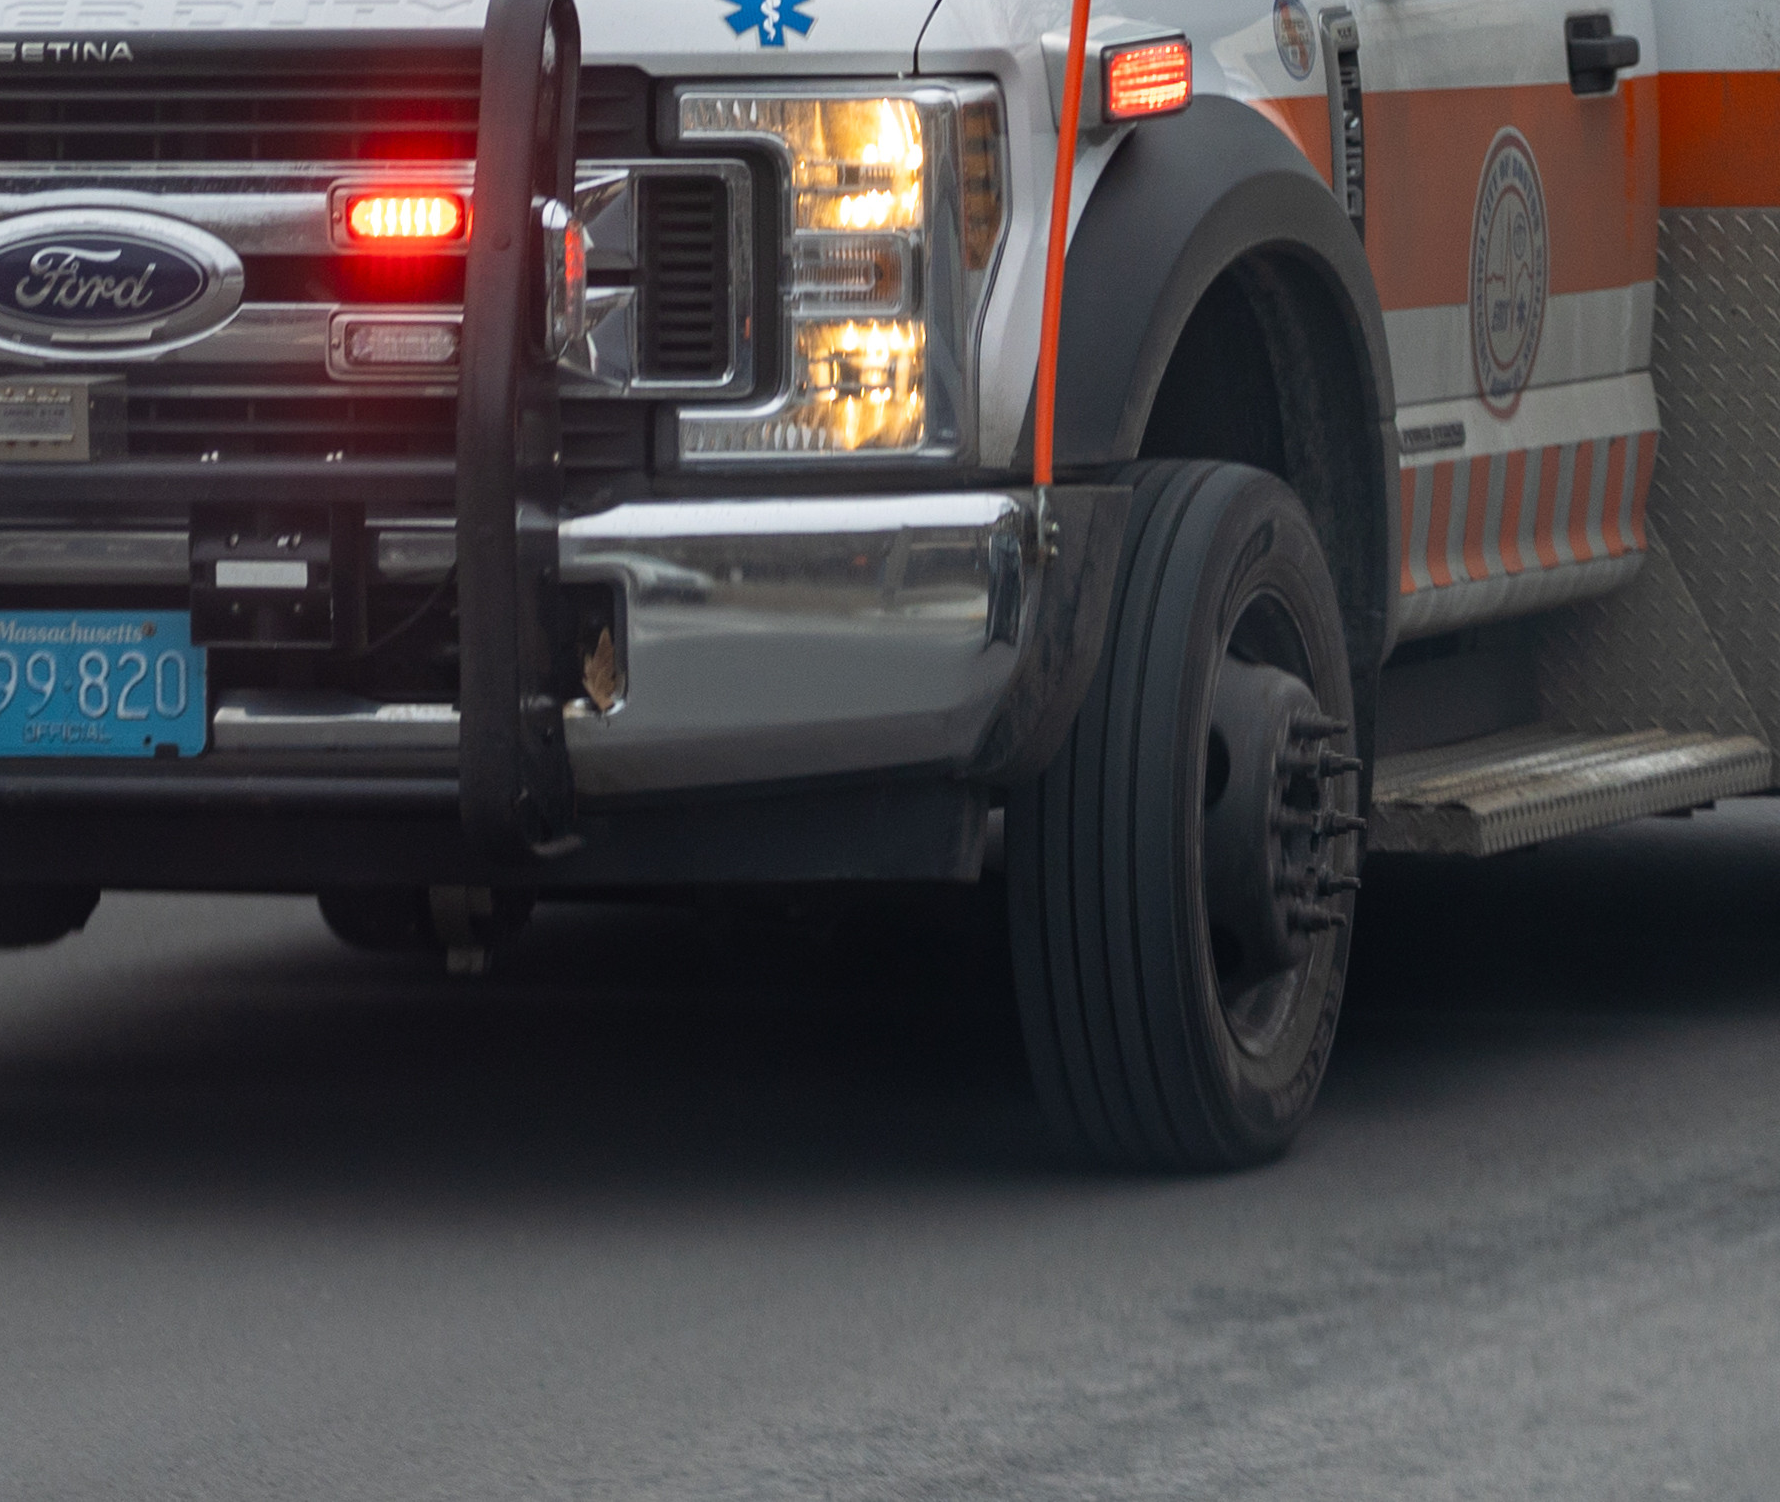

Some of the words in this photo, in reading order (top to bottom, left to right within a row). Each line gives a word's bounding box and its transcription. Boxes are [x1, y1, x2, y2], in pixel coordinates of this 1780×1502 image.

[14, 246, 157, 310] Ford
[78, 649, 188, 720] 820
[24, 720, 113, 744] OFFICIAL
